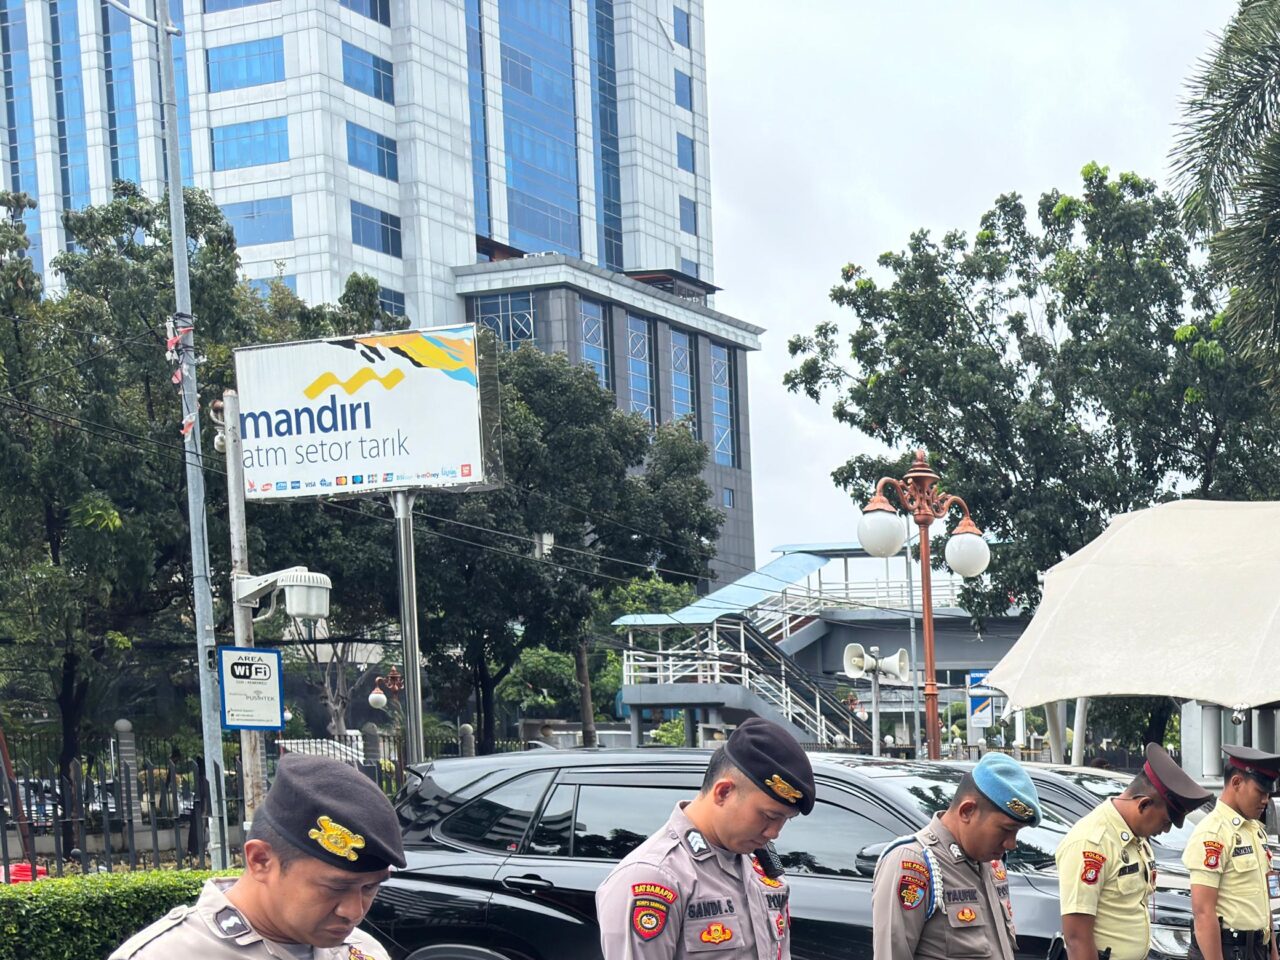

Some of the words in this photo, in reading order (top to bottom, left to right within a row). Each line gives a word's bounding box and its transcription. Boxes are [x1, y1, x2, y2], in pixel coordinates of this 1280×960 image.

[240, 394, 371, 440] mandiri
[243, 445, 287, 469] atm
[295, 439, 352, 465] setor
[358, 428, 411, 460] tarik
